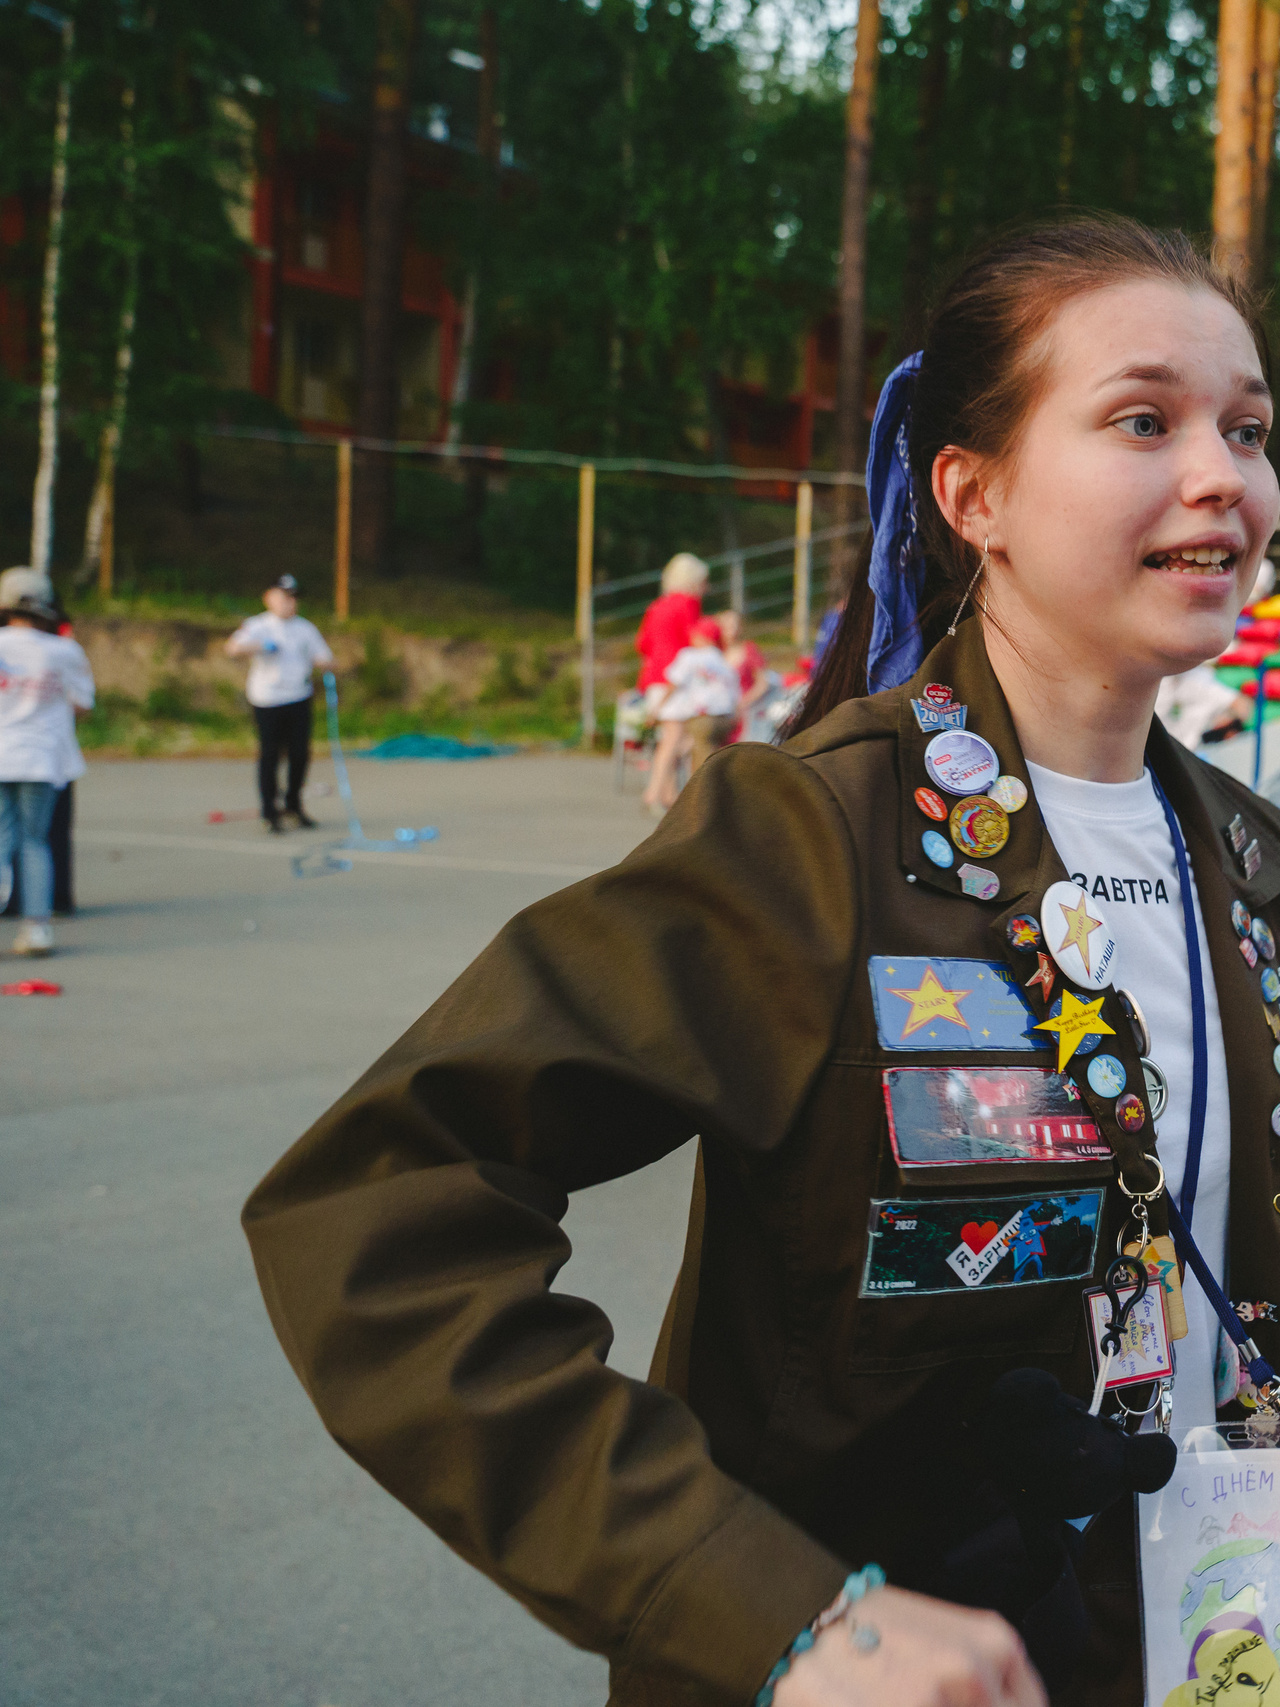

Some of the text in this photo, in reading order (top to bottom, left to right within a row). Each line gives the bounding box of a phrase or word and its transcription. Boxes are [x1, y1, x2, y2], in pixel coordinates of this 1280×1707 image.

[920, 707, 939, 723] 20
[1094, 938, 1116, 984] НАТАША
[917, 996, 947, 1010] STARS
[955, 1250, 971, 1269] Я
[1212, 1464, 1274, 1504] ДНЁМ
